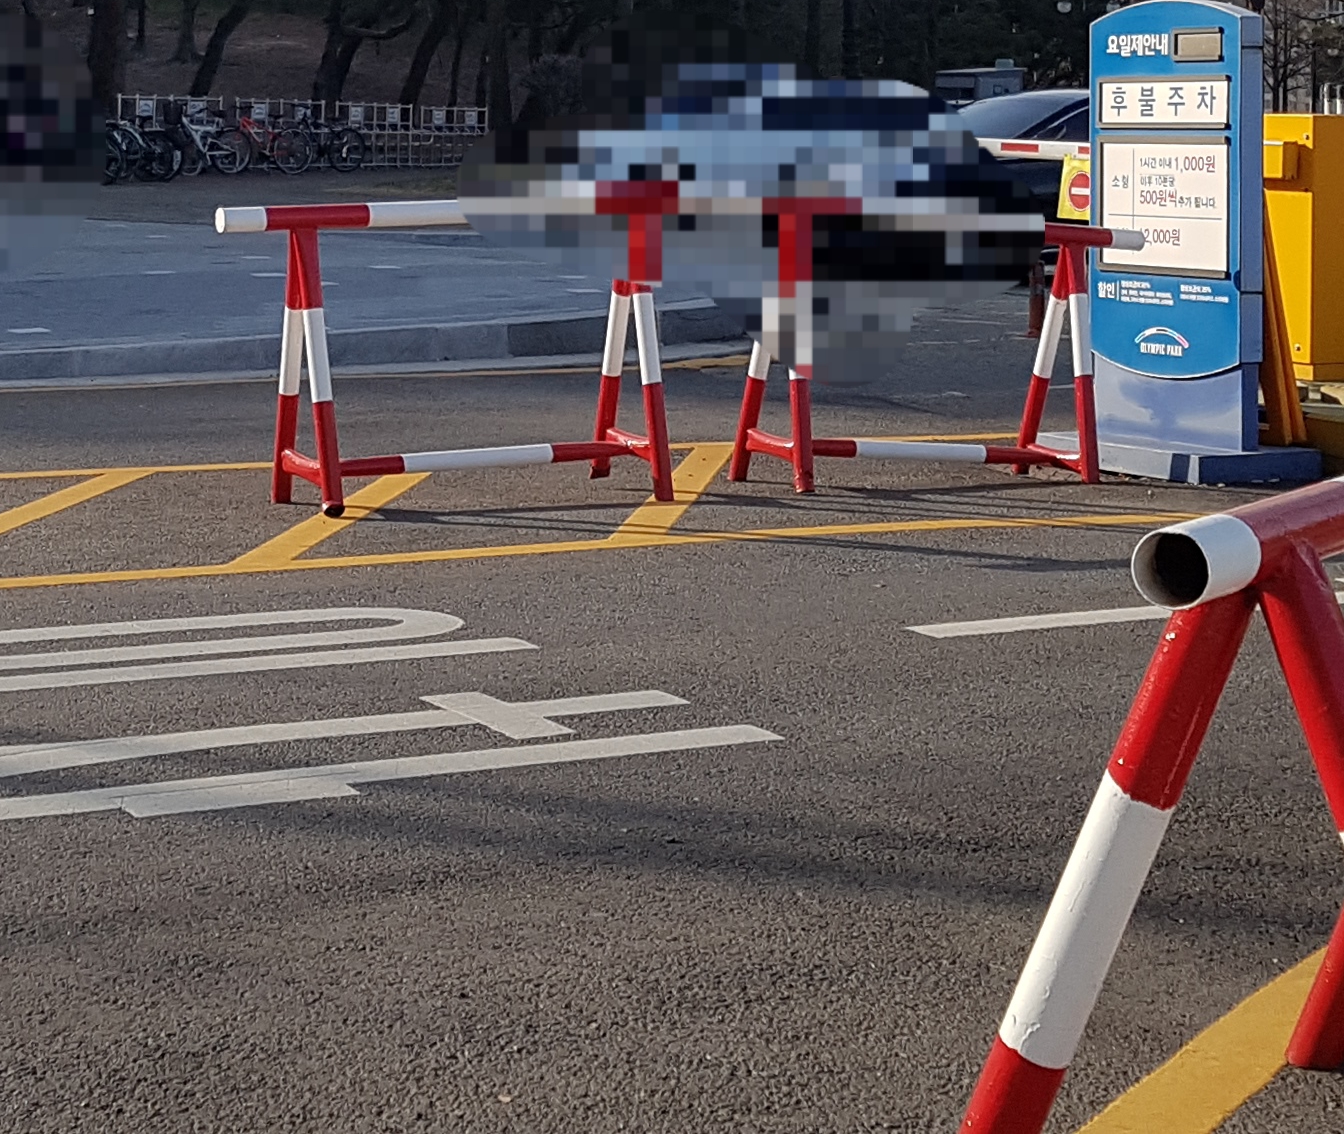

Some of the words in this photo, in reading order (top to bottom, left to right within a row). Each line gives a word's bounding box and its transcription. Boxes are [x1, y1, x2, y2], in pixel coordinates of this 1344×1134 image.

[1106, 33, 1169, 57] 요일제안내
[1140, 157, 1157, 168] 1시간
[1158, 157, 1172, 168] 이내
[1175, 155, 1216, 173] 1,000원
[1140, 175, 1153, 186] 이후
[1139, 189, 1177, 207] 500원씩
[1178, 196, 1192, 207] 추가
[1140, 228, 1181, 246] 2,000원
[1098, 281, 1115, 298] 할인
[1140, 342, 1166, 355] OLYMPIC
[1167, 345, 1183, 356] PARK
